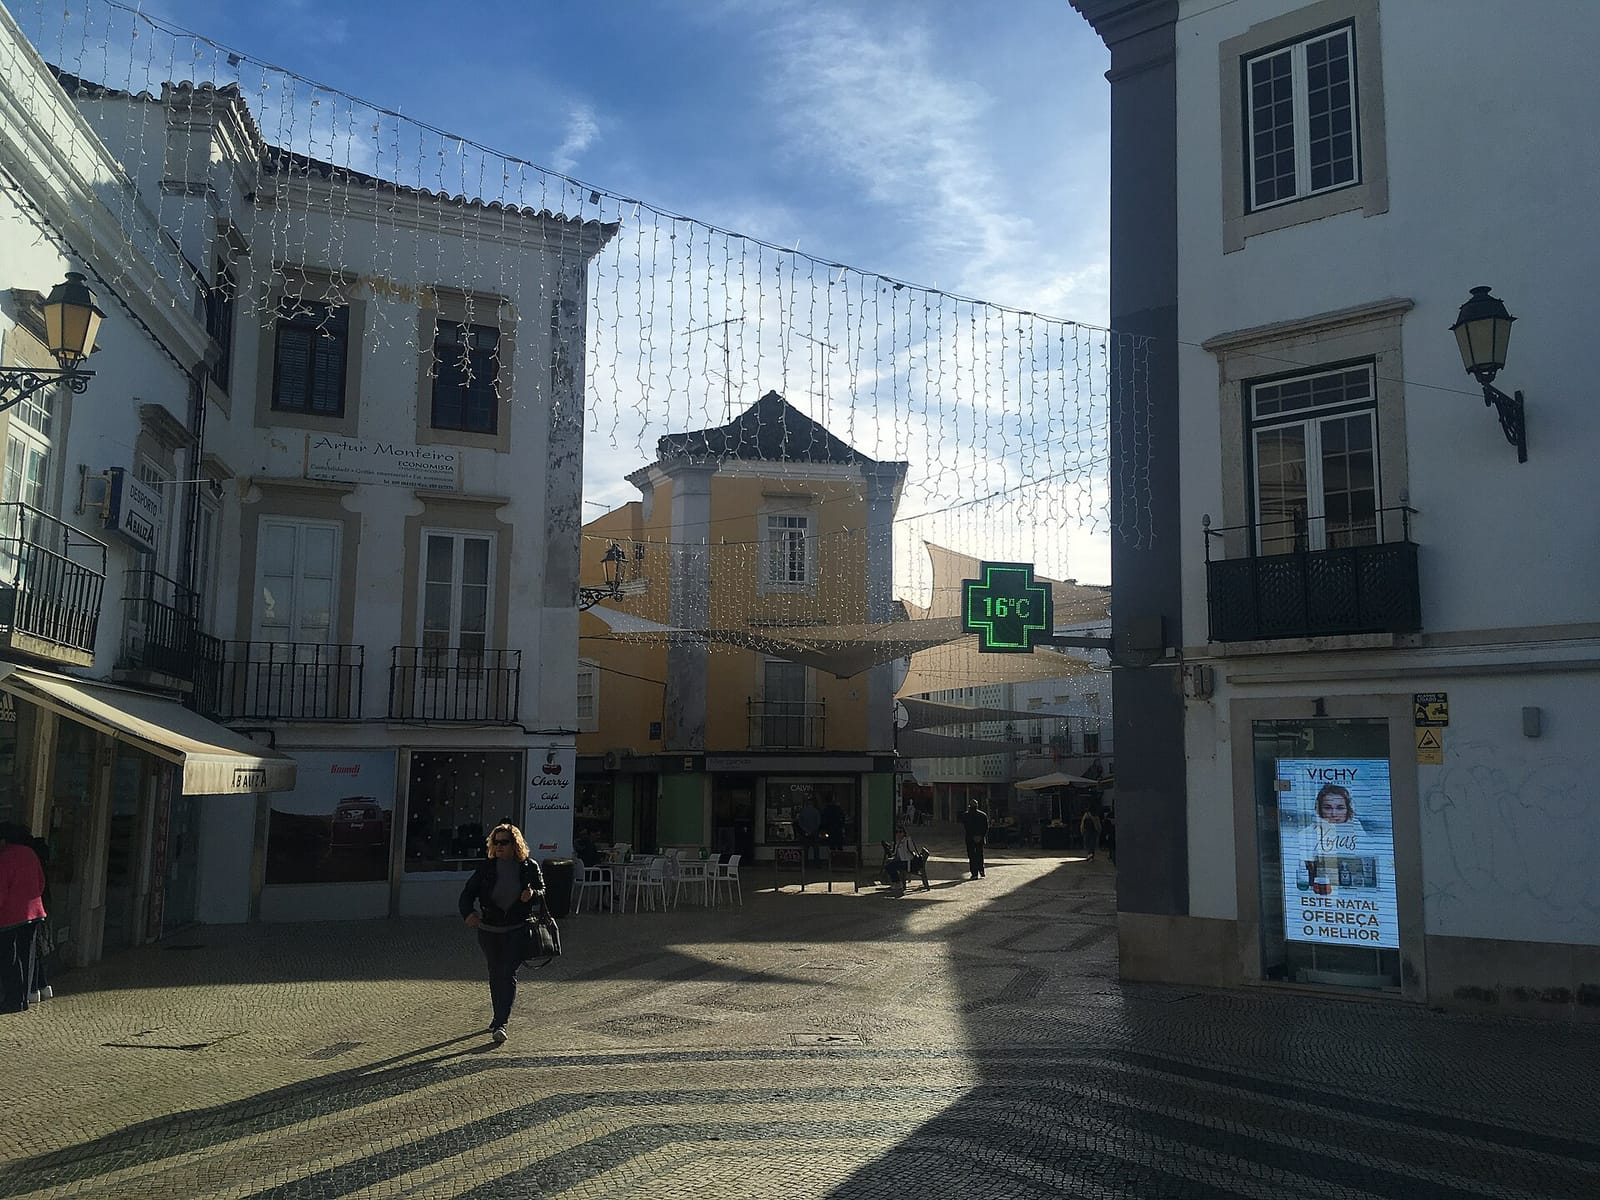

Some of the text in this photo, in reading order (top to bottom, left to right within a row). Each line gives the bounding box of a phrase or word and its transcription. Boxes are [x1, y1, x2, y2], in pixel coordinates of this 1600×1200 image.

[313, 437, 455, 462] Artur Monteiro
[398, 460, 455, 472] ECONOMISTA
[130, 485, 158, 517] DESPORTO
[125, 510, 154, 545] ABAUZA
[531, 775, 570, 788] Cherry
[1306, 768, 1358, 780] VICHY
[790, 784, 814, 792] CALVIN
[541, 792, 560, 801] Café
[1313, 824, 1358, 852] Xmas
[1301, 896, 1379, 911] ESTE NATAL
[1302, 909, 1379, 928] OFEREÇA
[1303, 925, 1380, 941] O MELHOR
